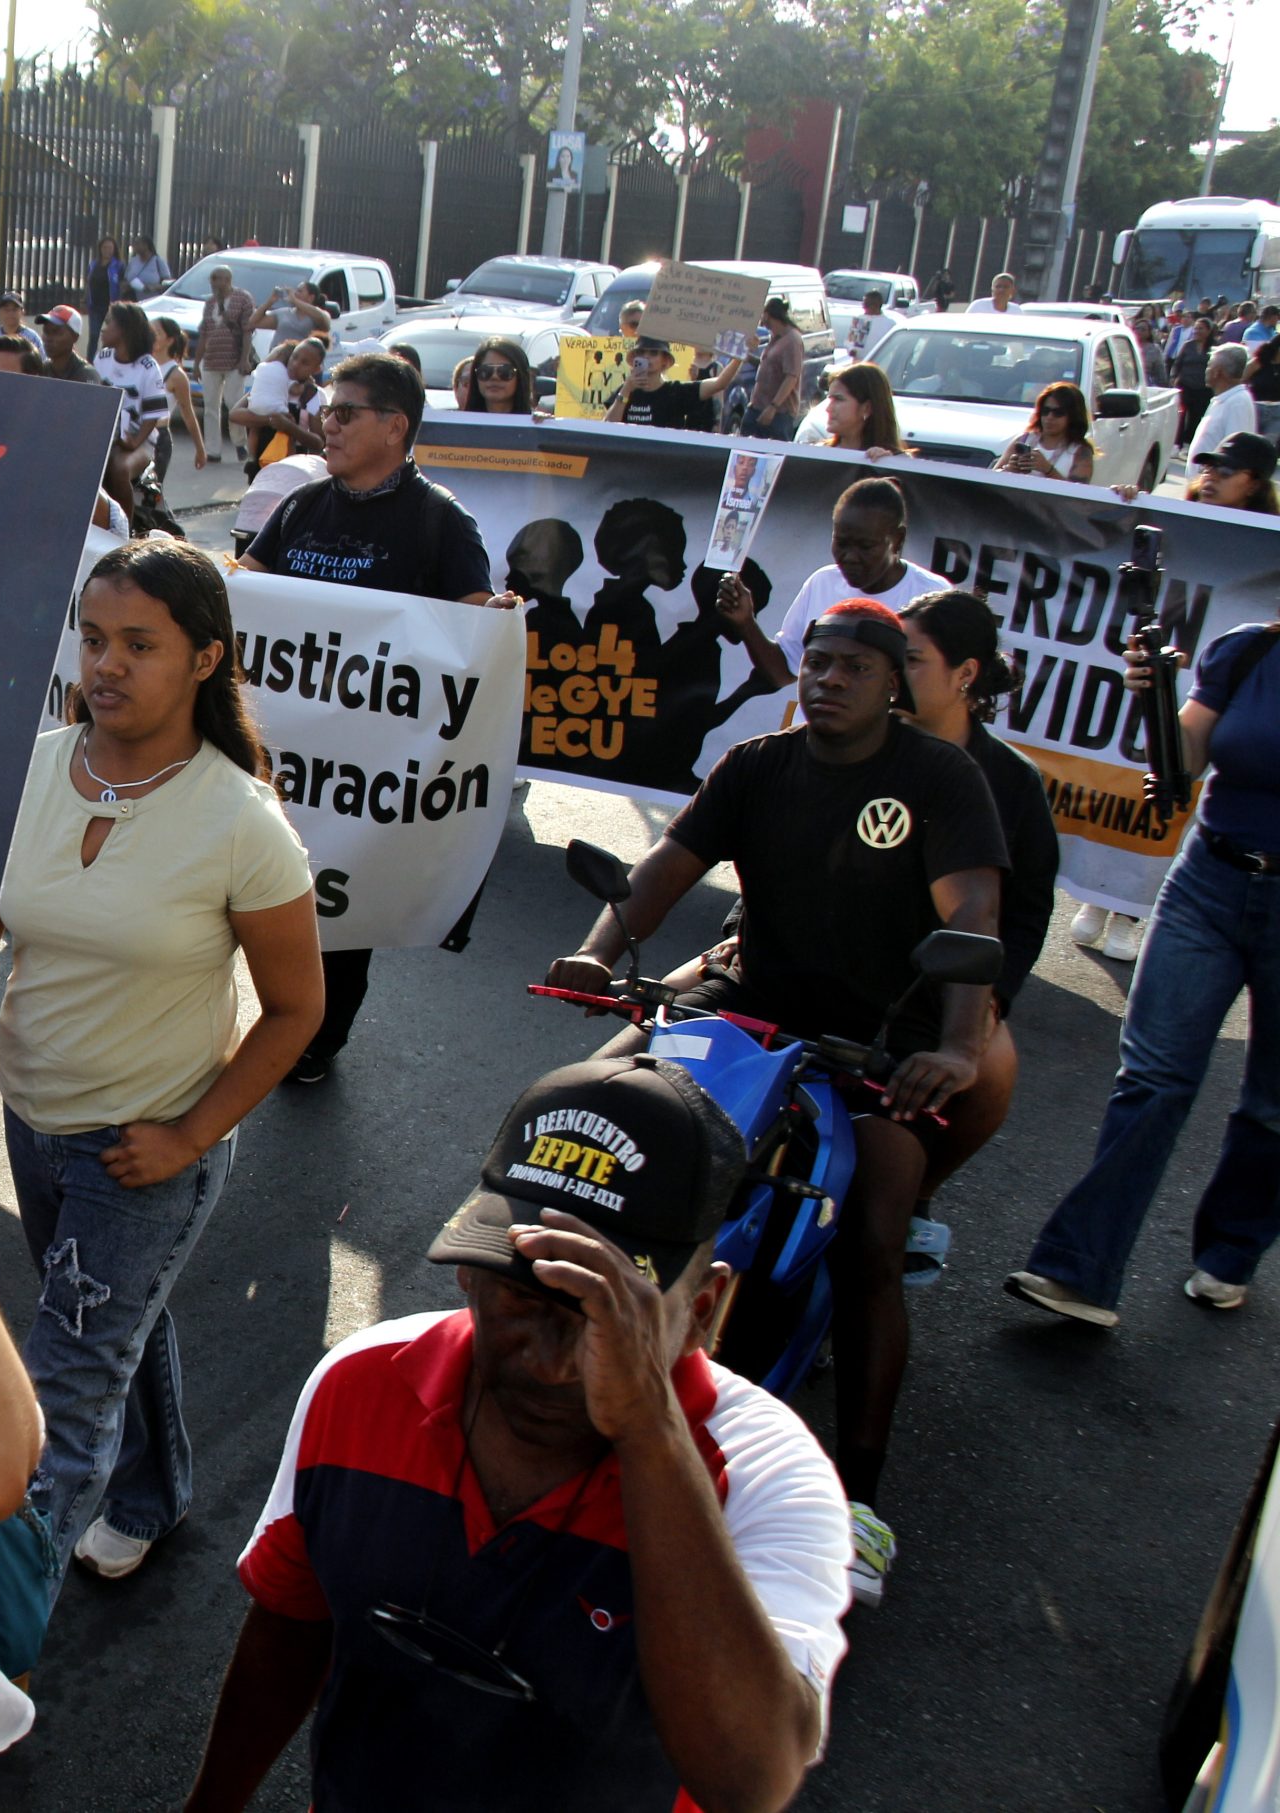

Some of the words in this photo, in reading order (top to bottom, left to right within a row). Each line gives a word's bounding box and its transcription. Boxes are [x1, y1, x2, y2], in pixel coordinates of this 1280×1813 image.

[565, 337, 598, 349] VERDAD
[287, 549, 374, 569] CASTIGLIONE
[290, 560, 316, 576] DEL
[320, 567, 357, 580] LAGO
[237, 630, 421, 720] usticia
[439, 673, 480, 741] y
[531, 716, 625, 760] ECU
[526, 1135, 619, 1185] EFPTE
[534, 1108, 646, 1173] REENCUENTRO
